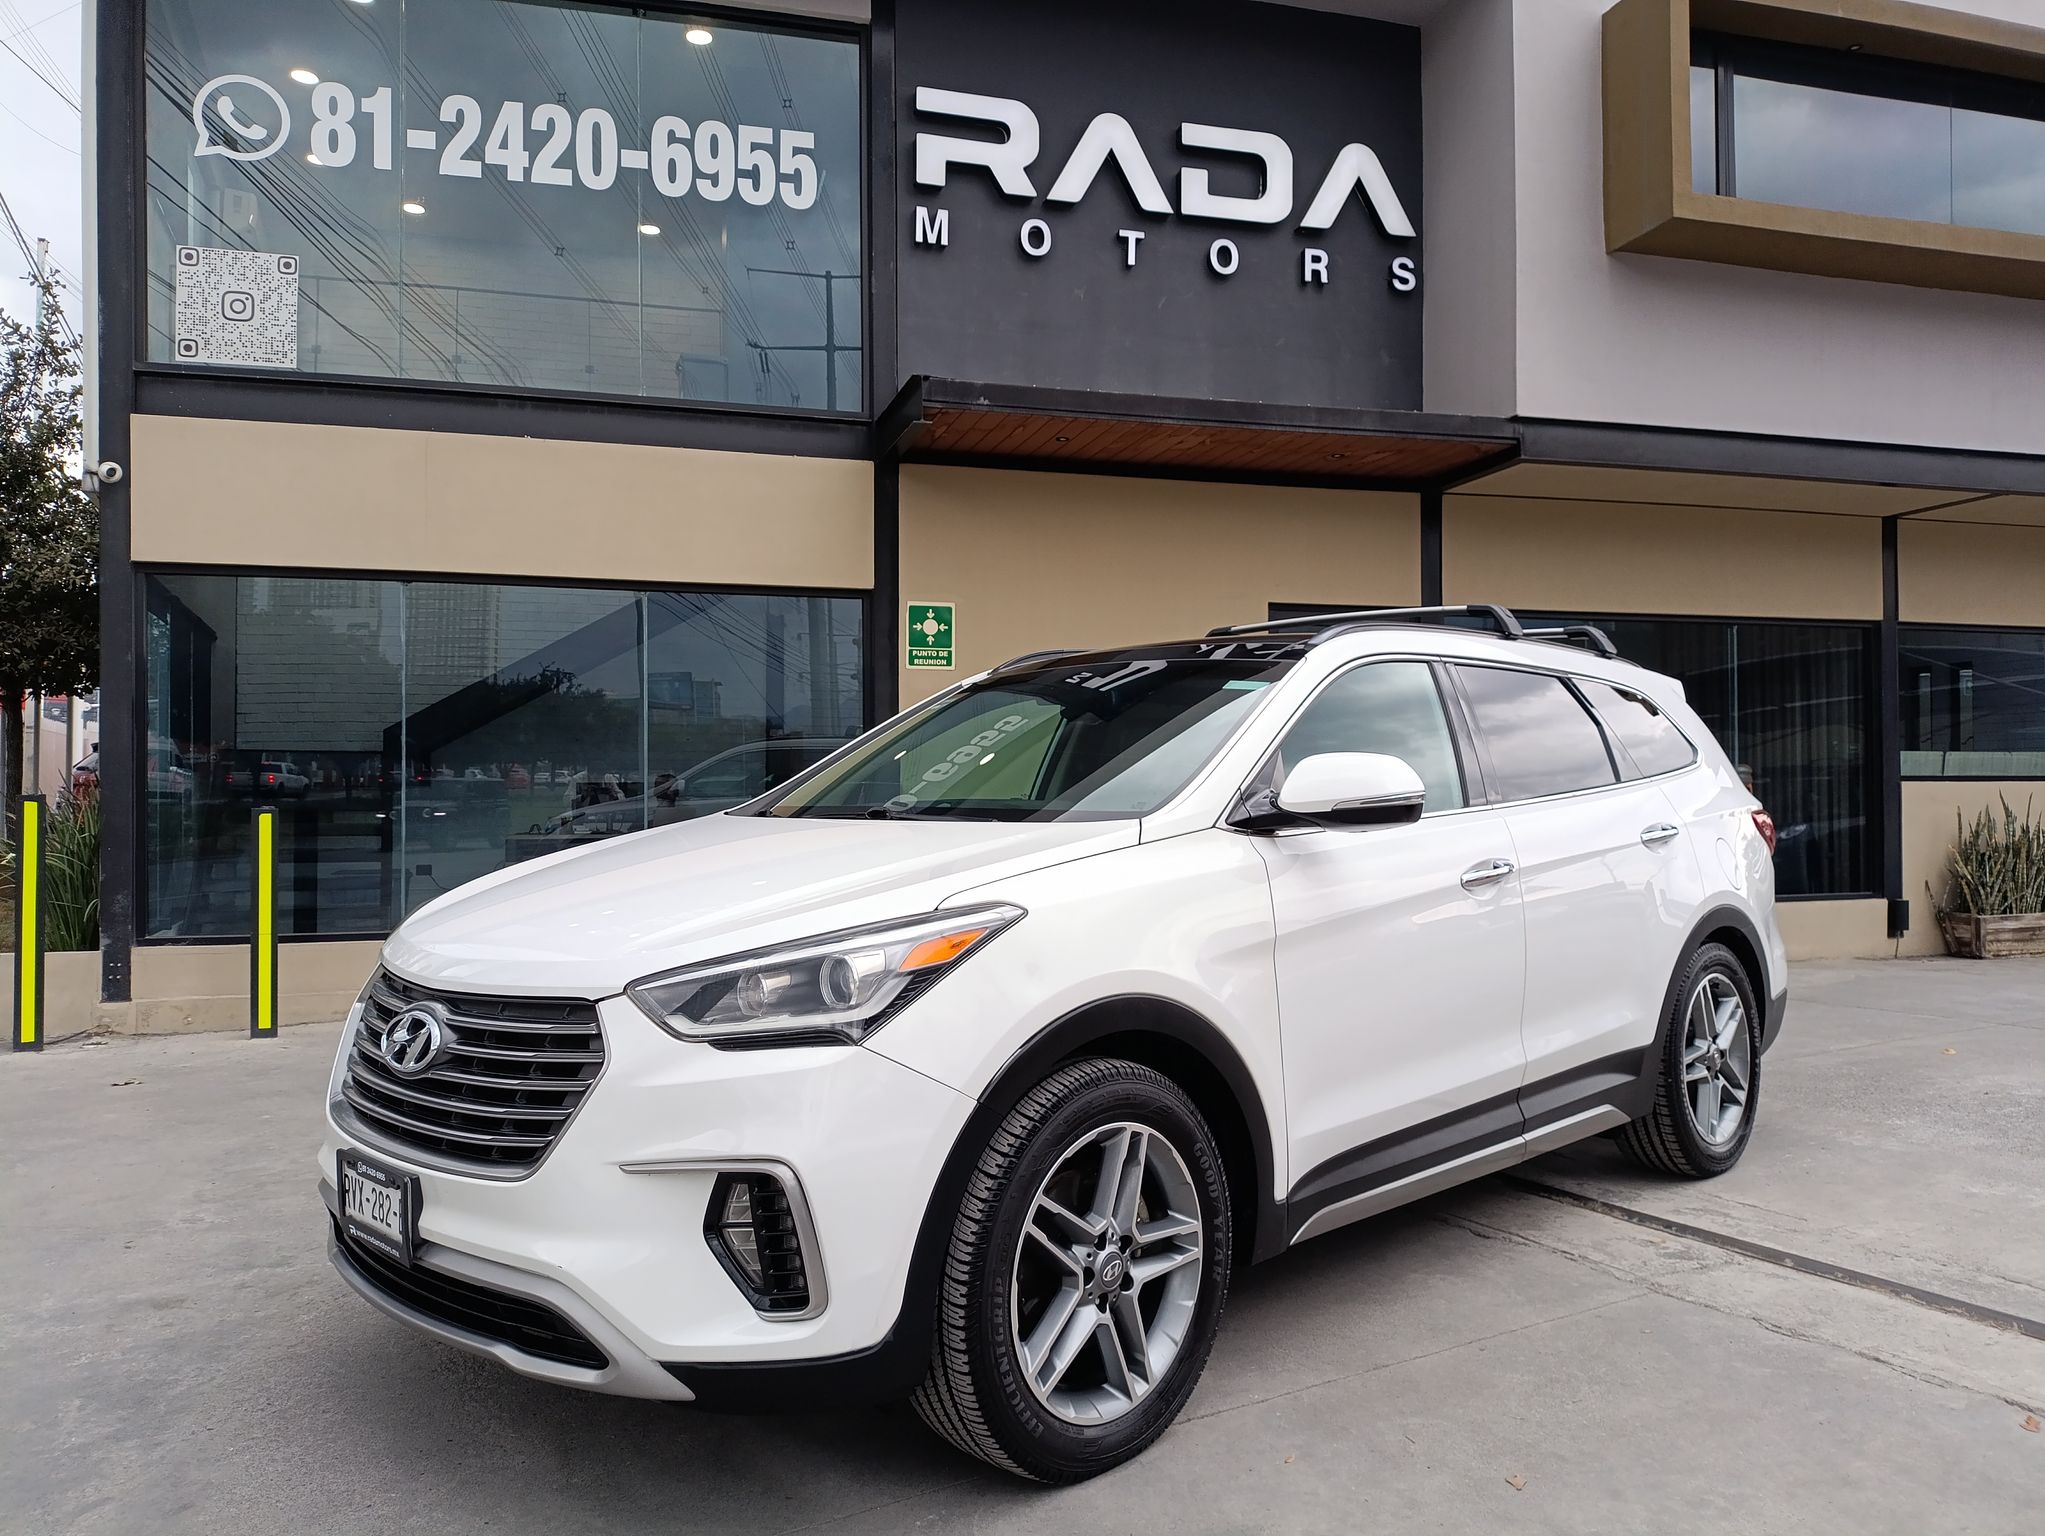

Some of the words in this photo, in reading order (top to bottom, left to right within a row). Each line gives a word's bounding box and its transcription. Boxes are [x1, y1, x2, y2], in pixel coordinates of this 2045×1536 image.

[310, 81, 819, 210] 81-2420-6955
[915, 86, 1417, 237] RADA
[914, 205, 1417, 291] MOTORS
[343, 1172, 403, 1236] RVX-282-
